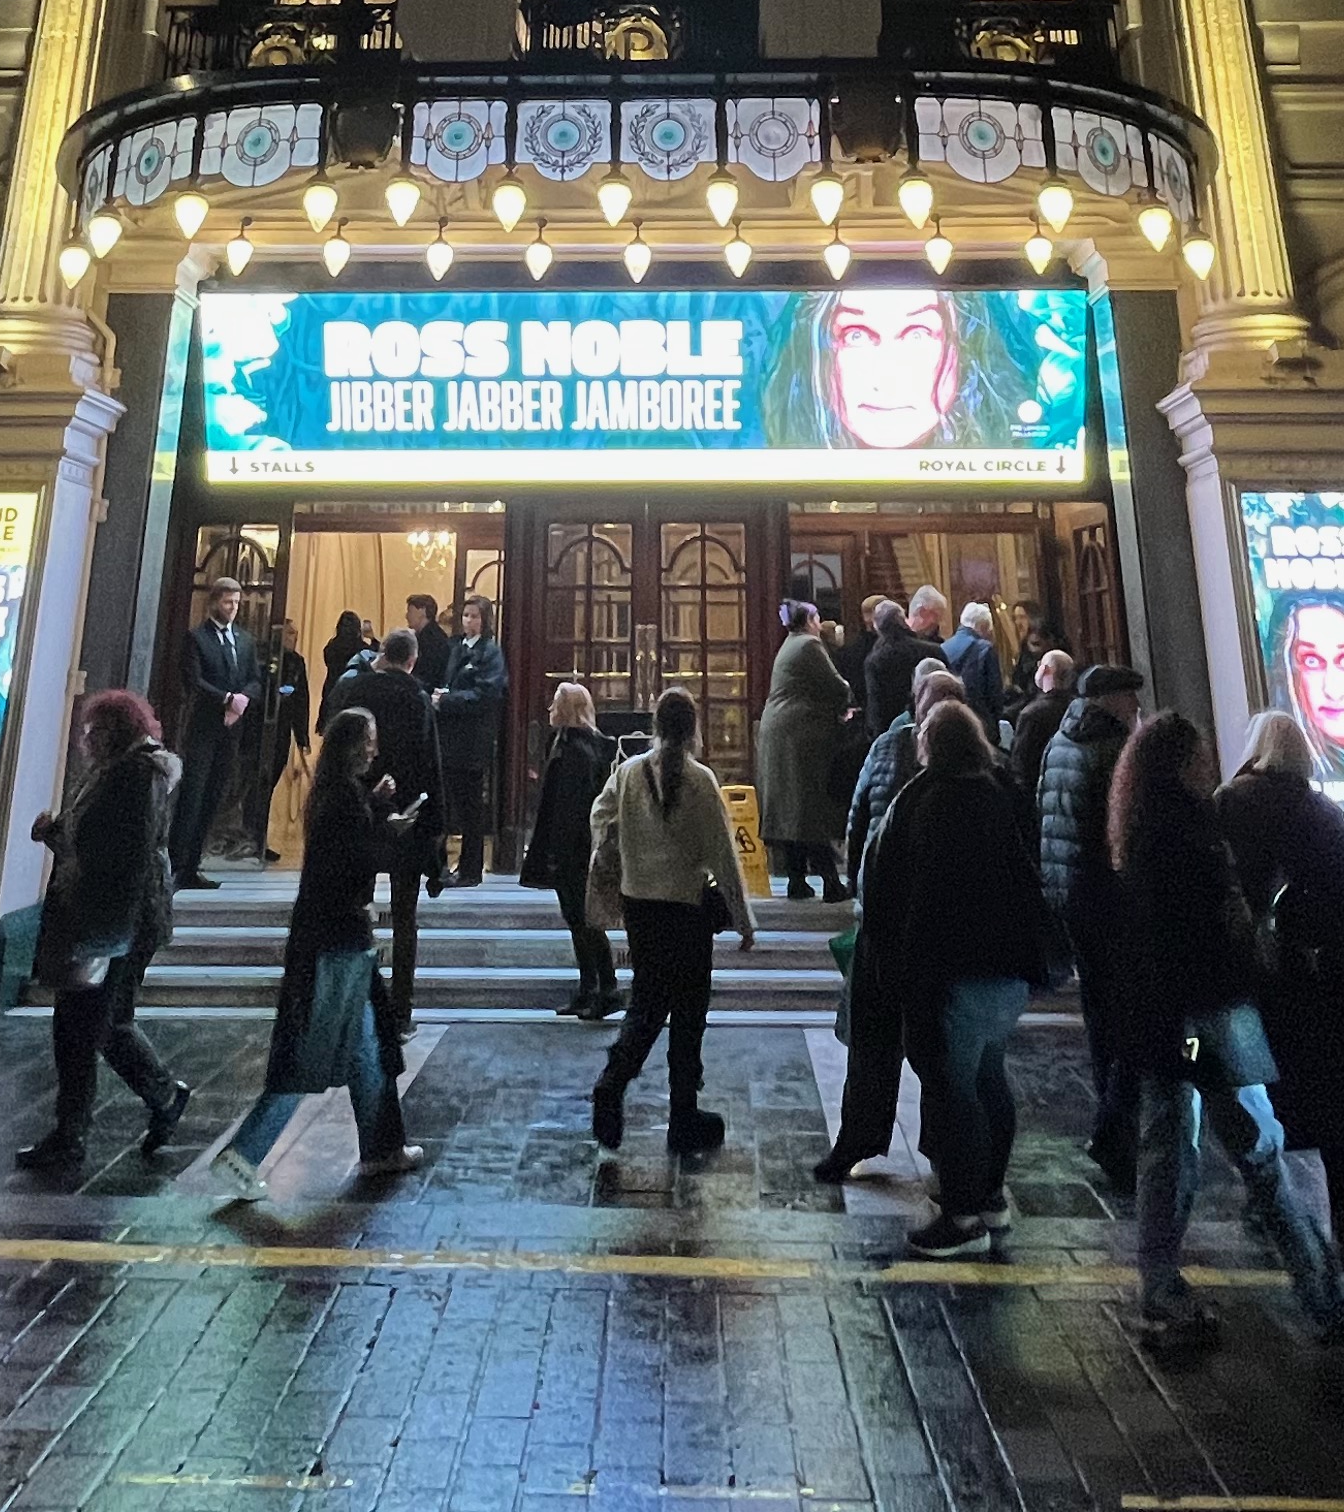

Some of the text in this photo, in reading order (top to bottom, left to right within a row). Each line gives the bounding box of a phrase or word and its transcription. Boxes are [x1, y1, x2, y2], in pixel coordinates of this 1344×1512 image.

[323, 319, 744, 378] ROSS NOBLE
[325, 379, 743, 432] JIBBER JABBER JAMBOREE
[250, 461, 315, 473] STALLS
[919, 460, 1047, 472] ROYAL CIRCLE
